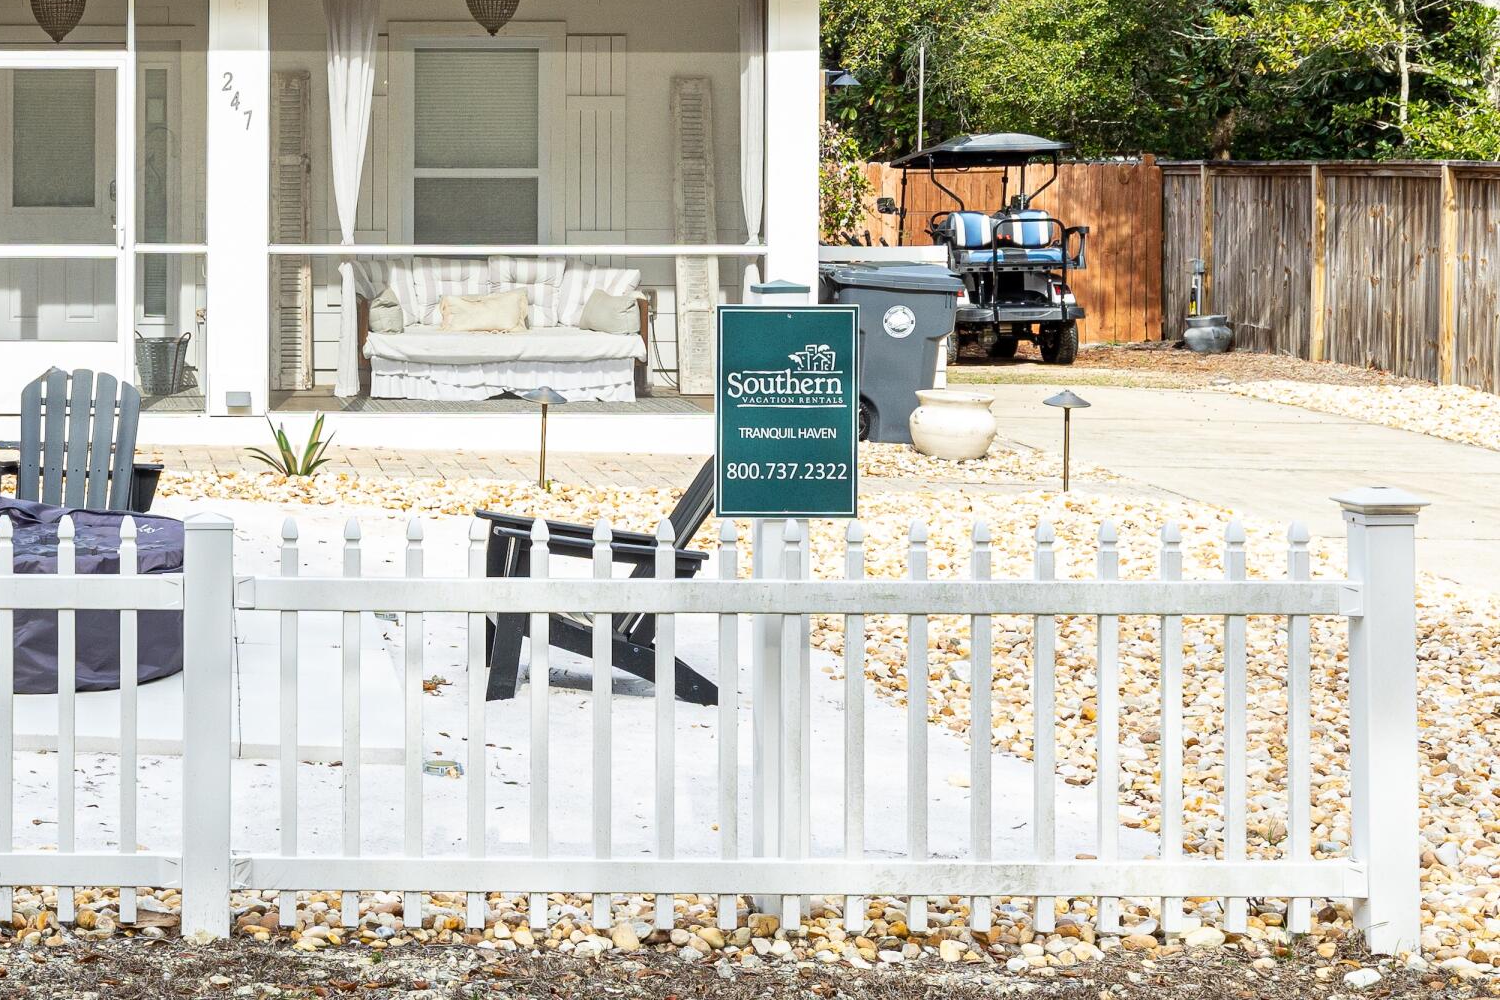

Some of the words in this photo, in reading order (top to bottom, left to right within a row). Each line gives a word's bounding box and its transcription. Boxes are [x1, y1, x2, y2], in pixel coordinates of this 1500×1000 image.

[221, 71, 253, 131] 247
[727, 368, 844, 398] Southern
[742, 396, 795, 404] VACATION
[798, 396, 844, 404] RENTALS
[738, 427, 797, 440] TRANQUIL
[798, 427, 837, 439] HAVEN
[726, 462, 848, 480] 800.737.2322
